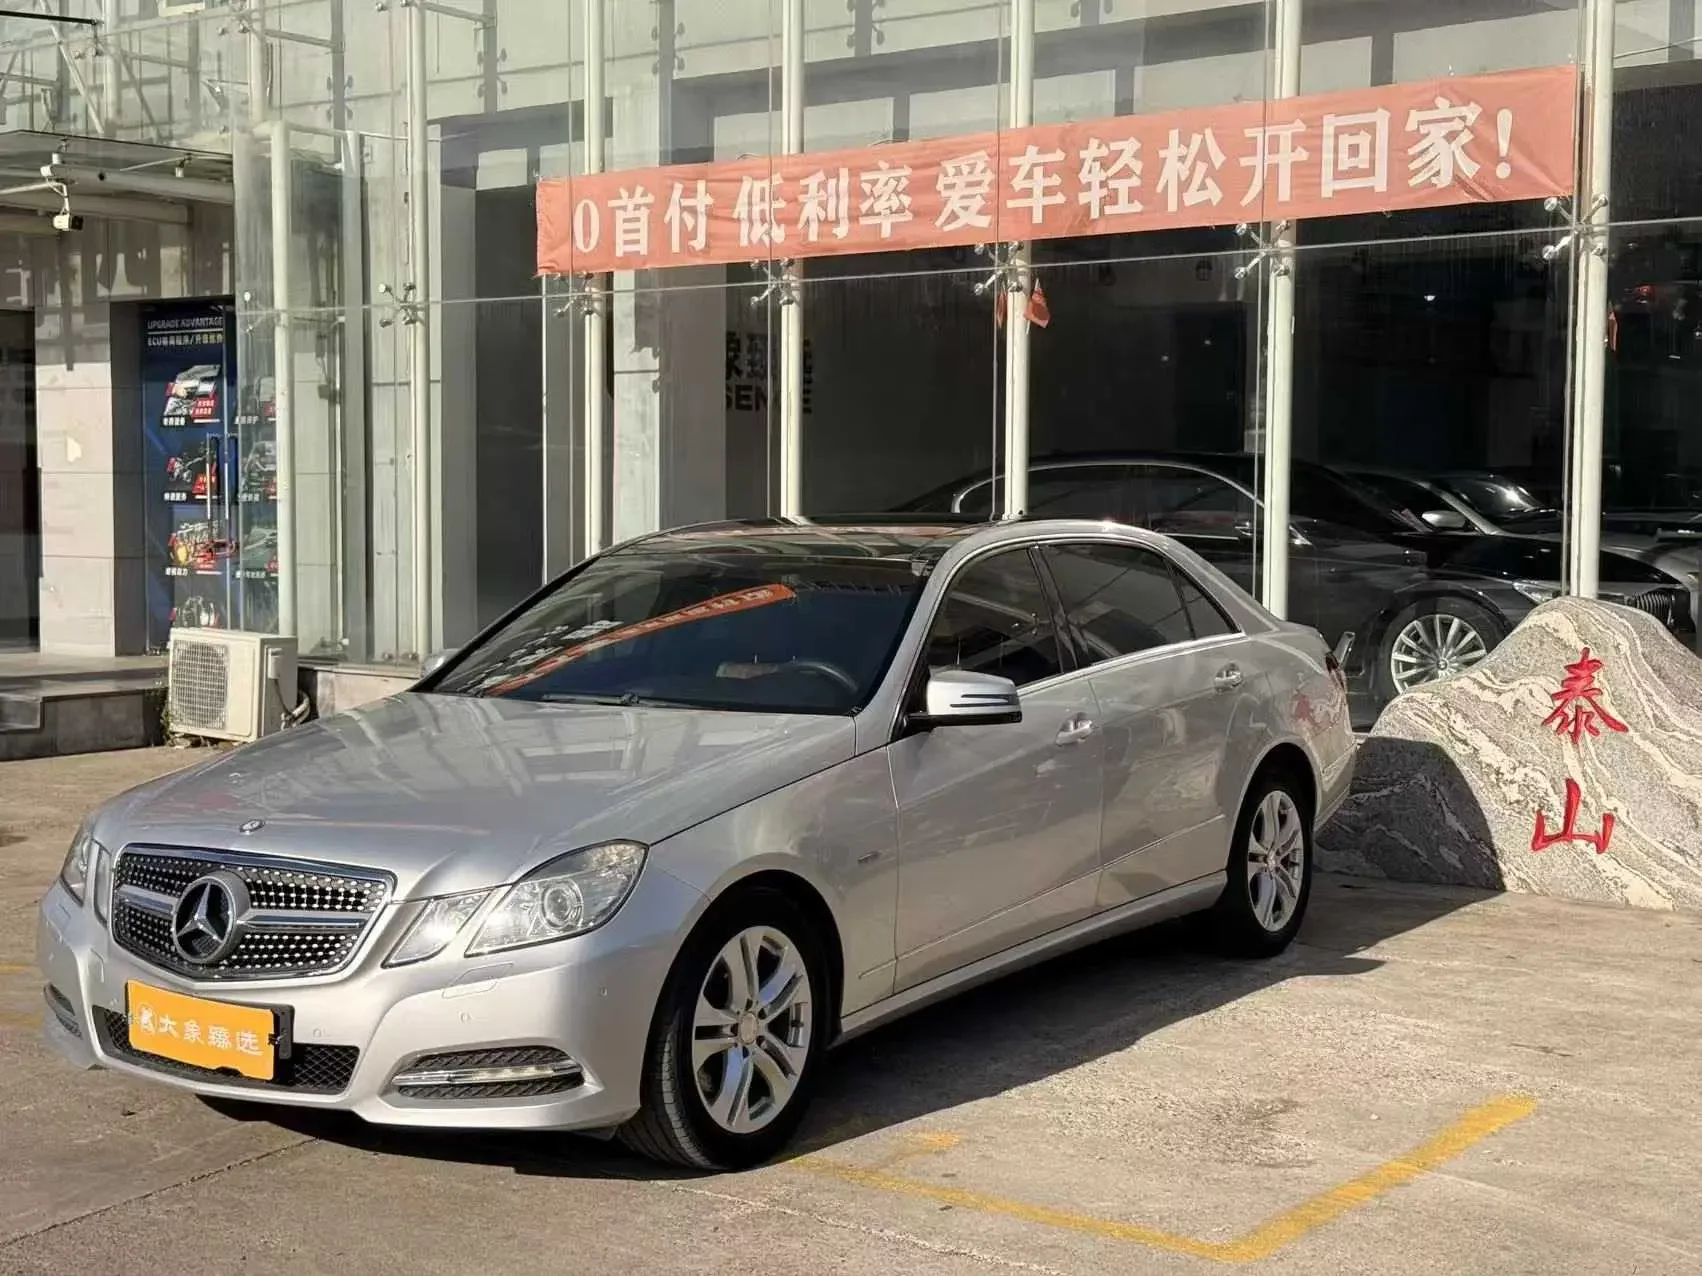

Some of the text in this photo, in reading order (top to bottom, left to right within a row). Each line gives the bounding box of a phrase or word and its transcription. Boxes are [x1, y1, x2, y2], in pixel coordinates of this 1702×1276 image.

[573, 180, 714, 257] 0首付
[733, 161, 913, 248] 低利率
[147, 316, 223, 329] UPGRADE ADVANTAGE
[1531, 647, 1629, 855] 泰山
[158, 1014, 265, 1057] 大象臻选
